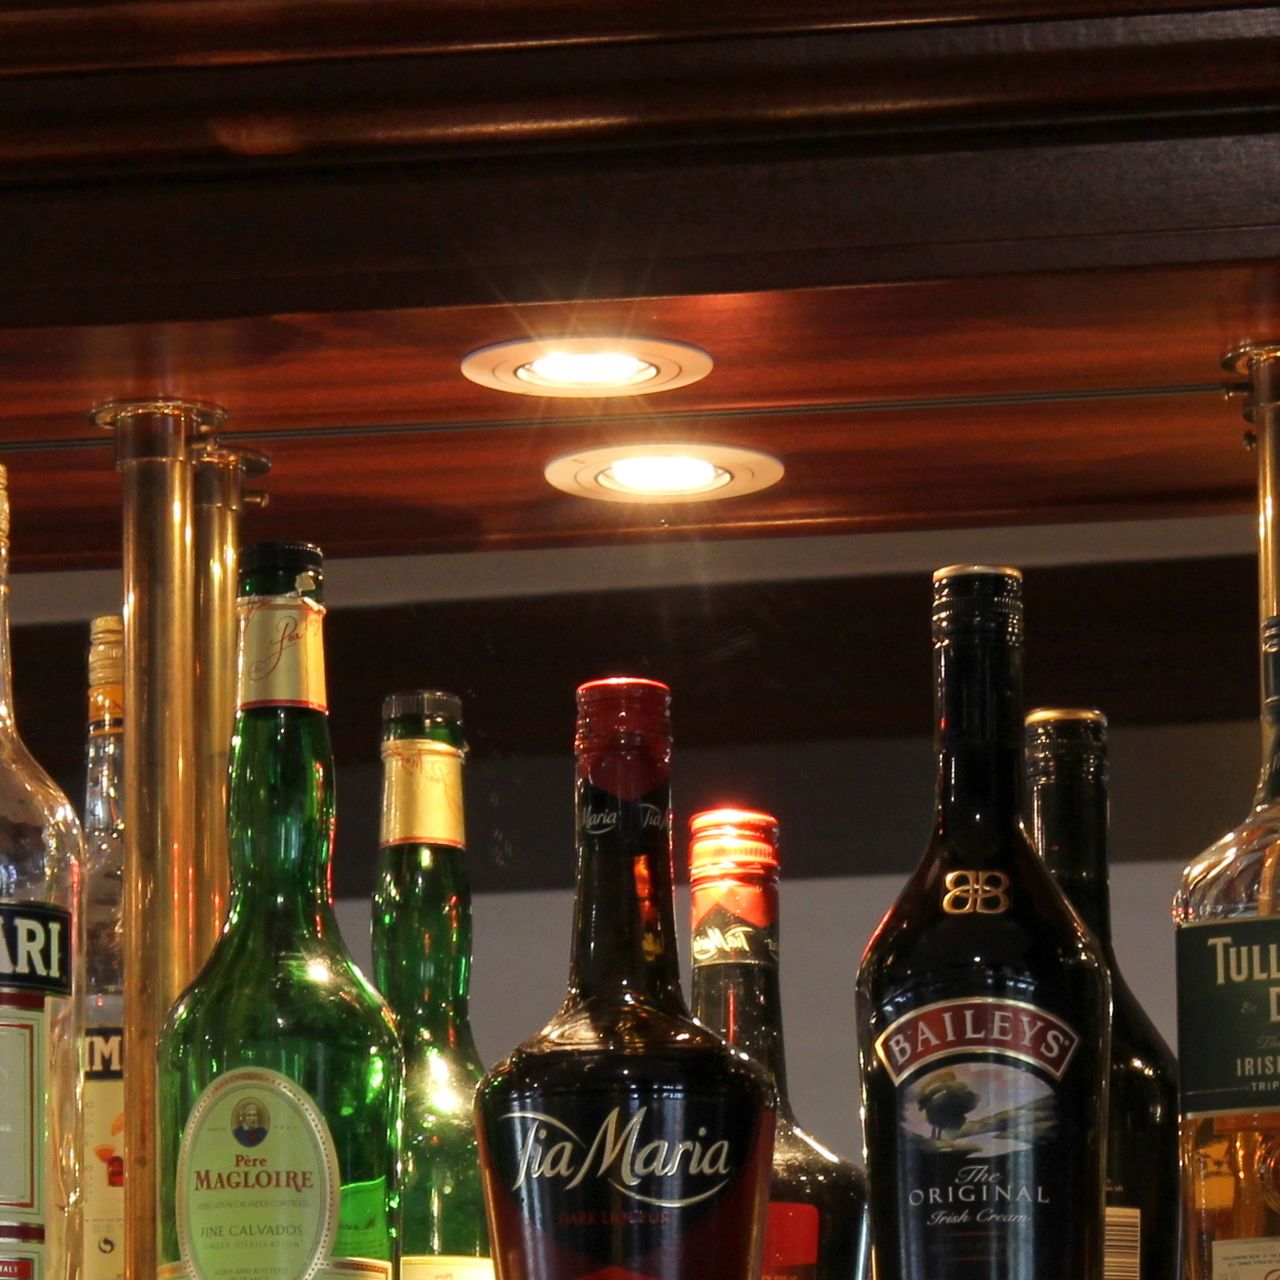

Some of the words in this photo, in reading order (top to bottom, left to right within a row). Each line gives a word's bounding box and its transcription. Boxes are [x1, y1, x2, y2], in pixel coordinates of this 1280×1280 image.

[887, 1009, 1067, 1066] BAILEYS
[498, 1110, 586, 1192] Tia
[564, 1105, 731, 1192] Maria
[235, 1153, 268, 1169] Père
[194, 1169, 314, 1193] MAGLOIRE
[955, 1165, 1003, 1184] The
[909, 1184, 1050, 1207] ORIGINAL
[558, 1213, 598, 1226] DARK
[602, 1211, 670, 1225] LIQUEUR
[926, 1209, 970, 1227] Irish
[975, 1207, 1031, 1224] Cream
[200, 1225, 225, 1237] FINE
[228, 1223, 304, 1237] CALVADOS
